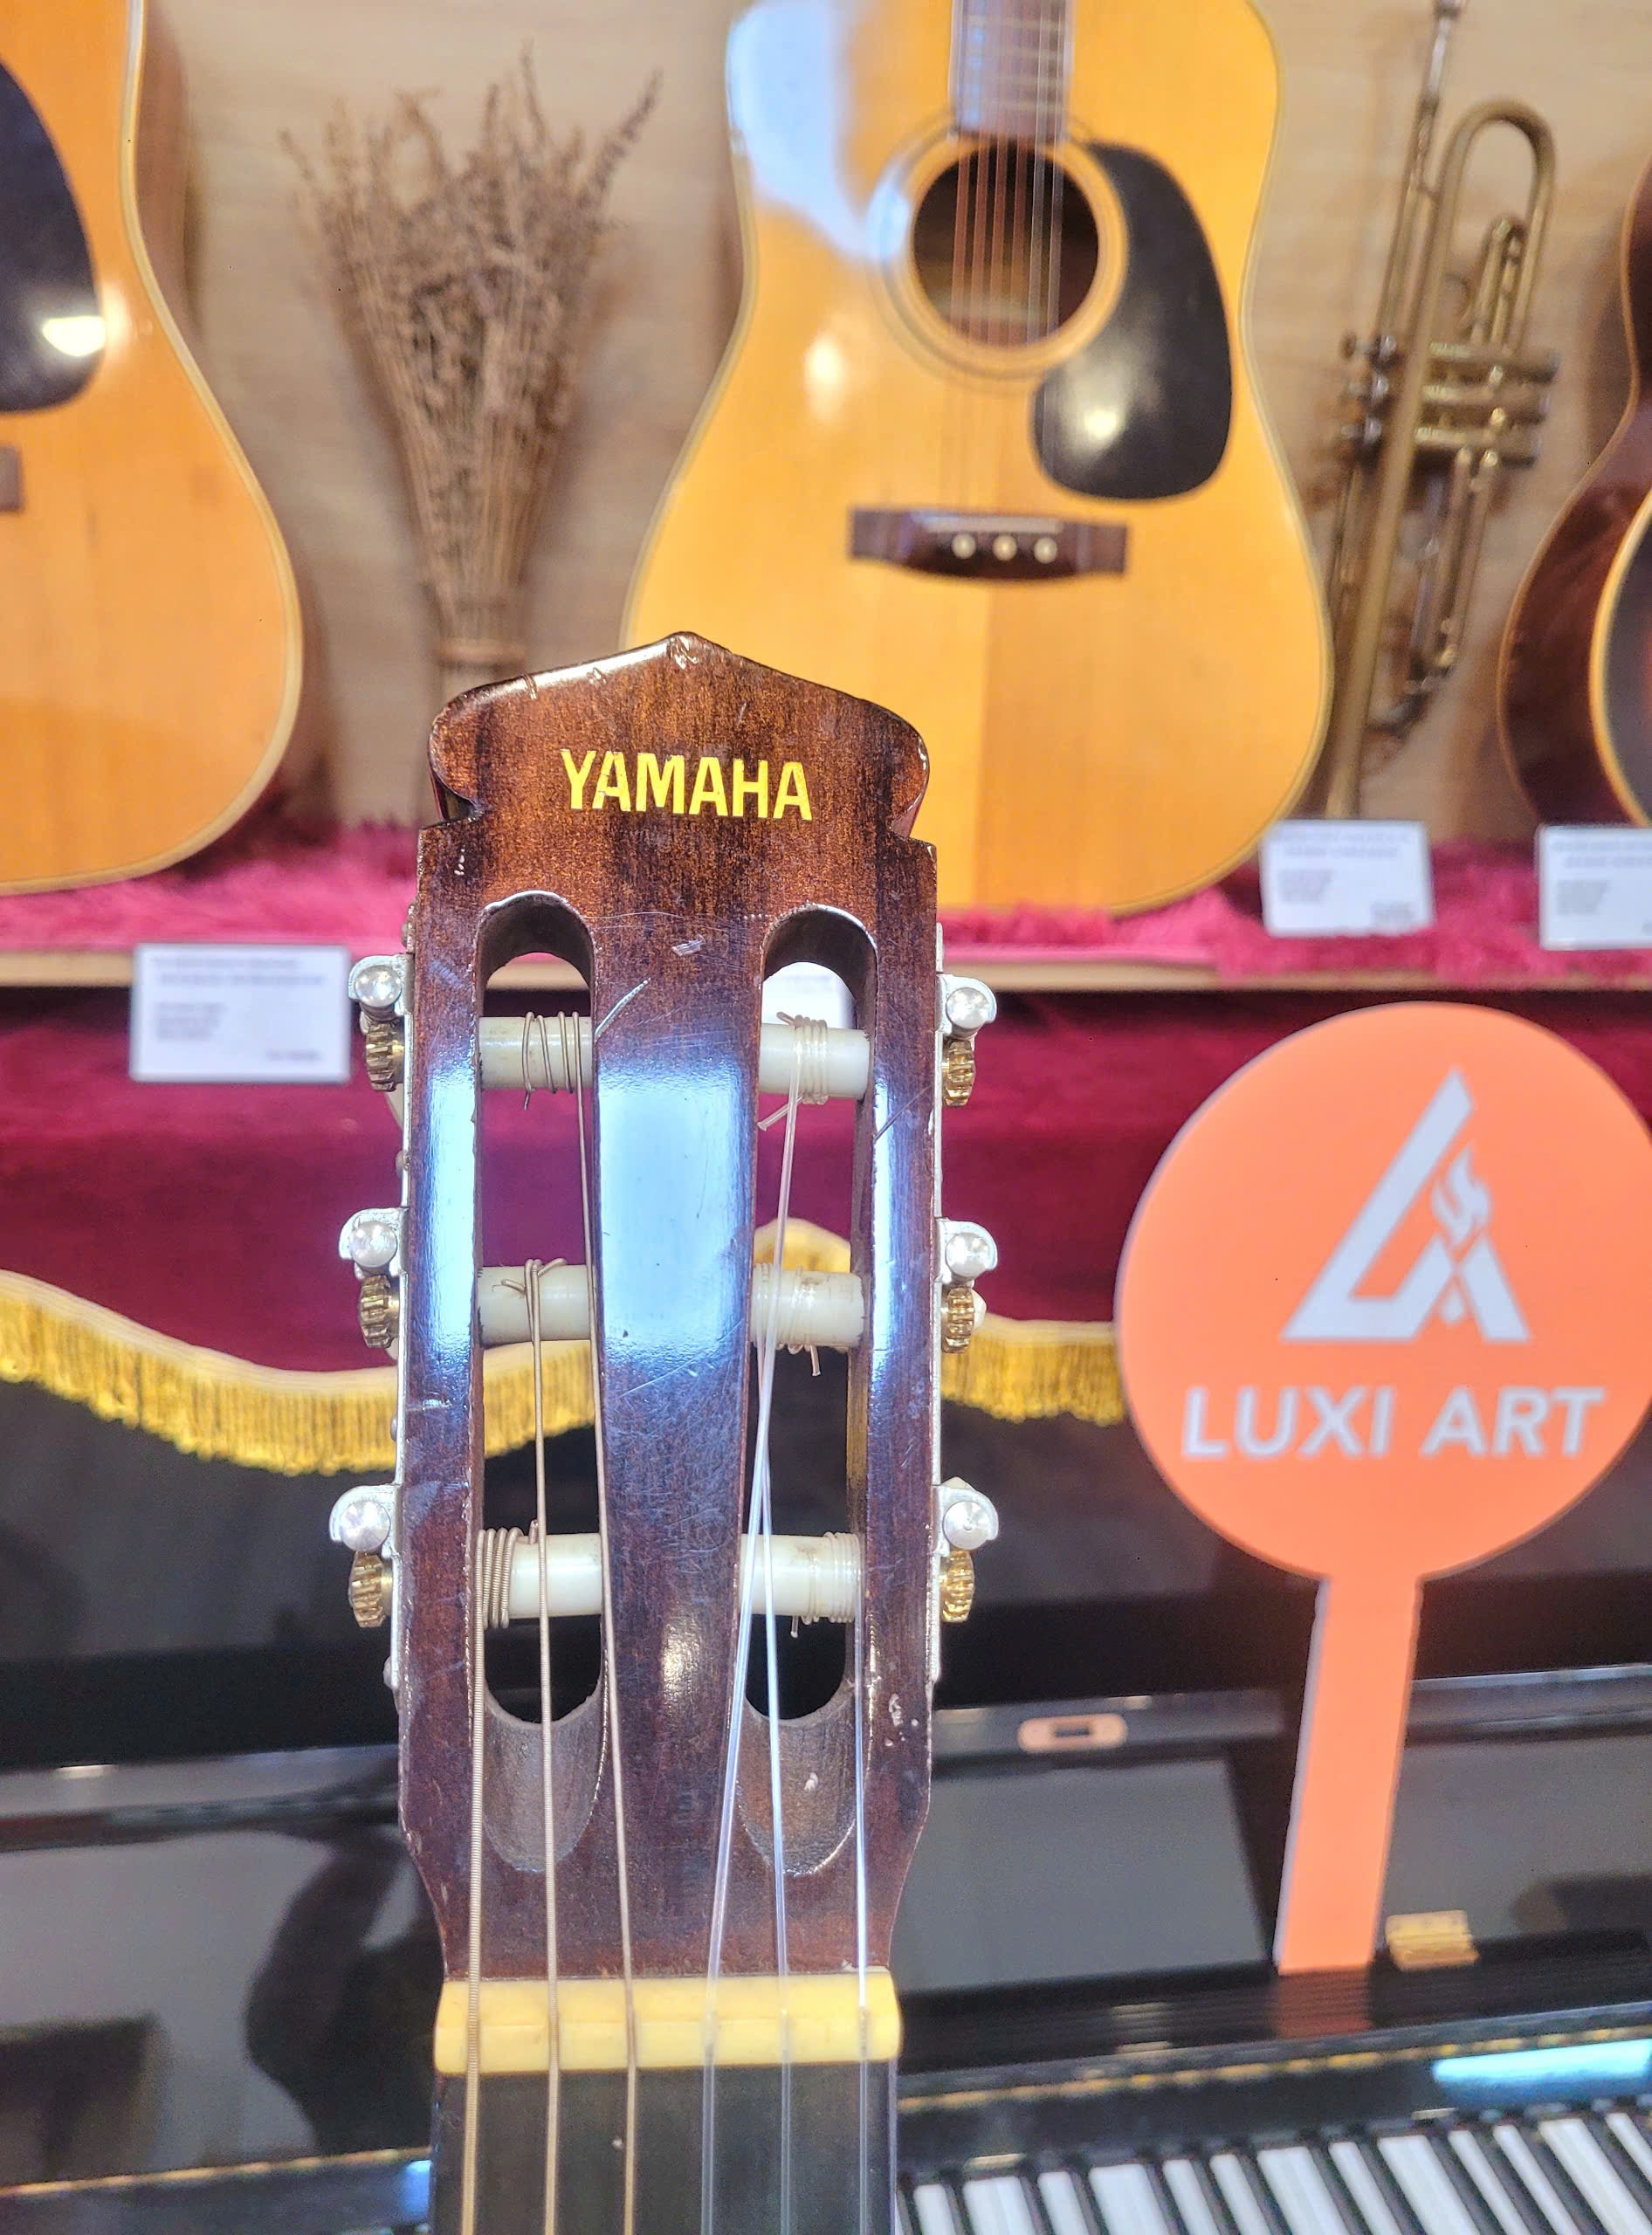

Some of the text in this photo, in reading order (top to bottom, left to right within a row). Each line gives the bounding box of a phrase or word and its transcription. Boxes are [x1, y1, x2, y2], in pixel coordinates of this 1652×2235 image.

[561, 748, 813, 821] YAMAHA
[1182, 1386, 1605, 1458] LUXI ART
